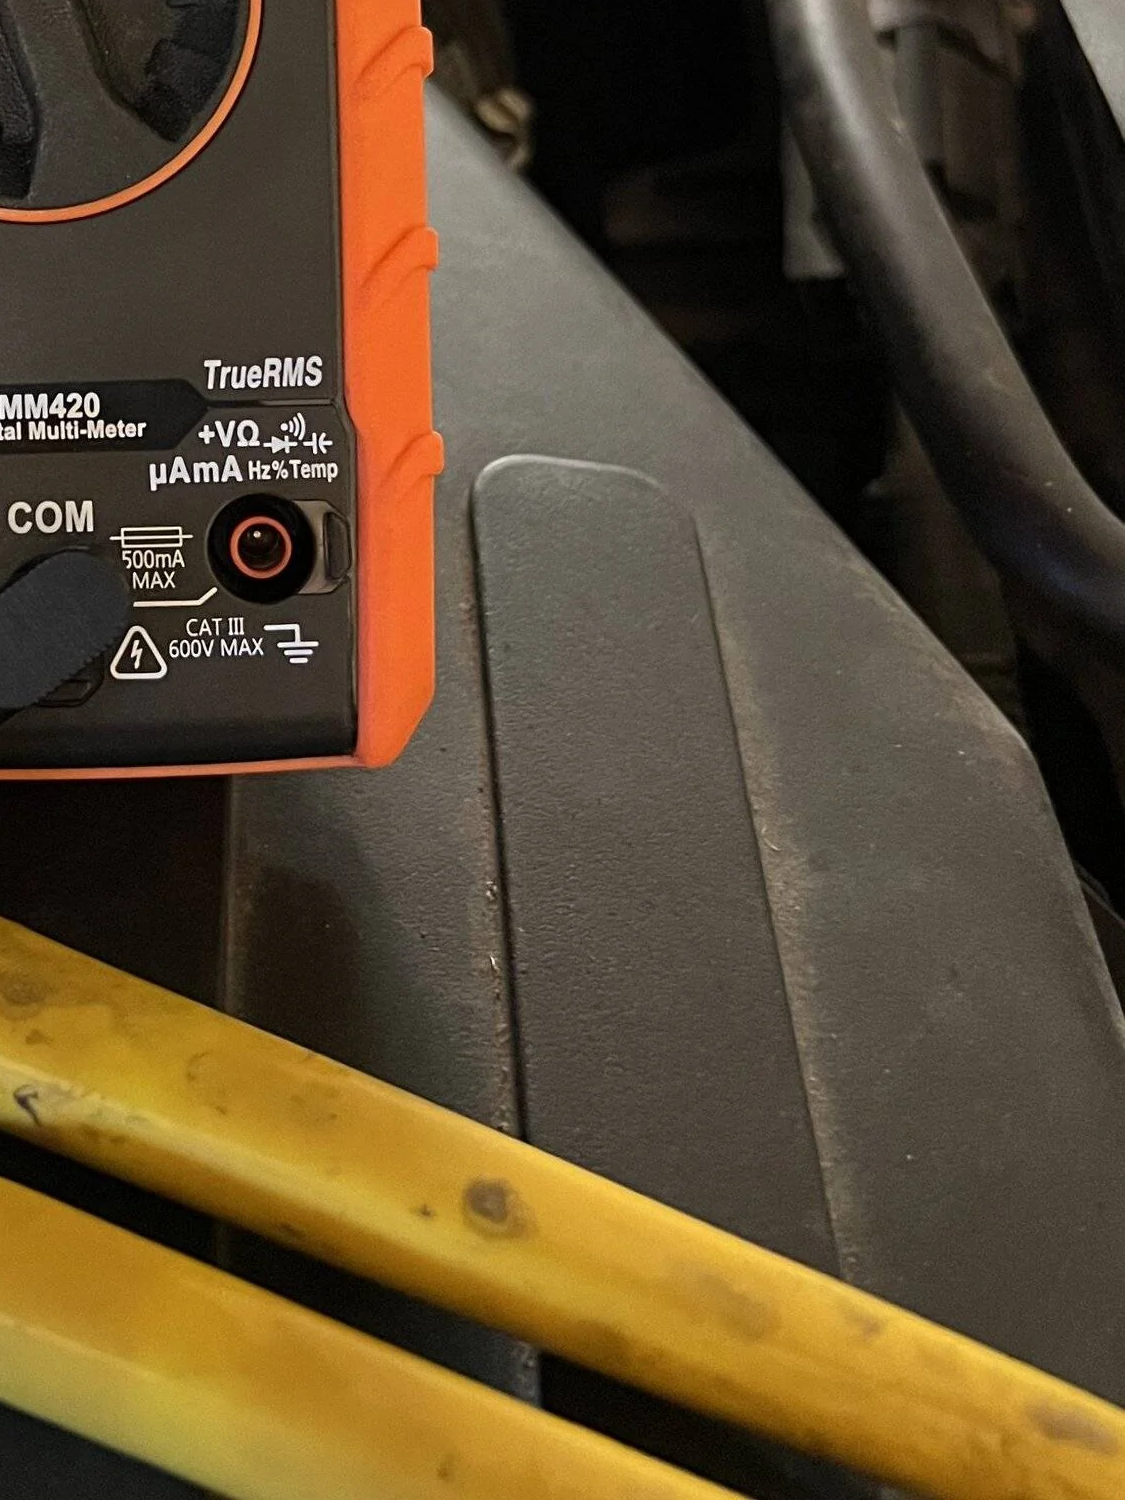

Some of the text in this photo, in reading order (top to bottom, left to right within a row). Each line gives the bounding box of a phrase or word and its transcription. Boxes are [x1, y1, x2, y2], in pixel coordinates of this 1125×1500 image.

[204, 356, 323, 390] TrueRMS
[28, 419, 147, 442] Multi-Meter
[8, 501, 94, 533] COM
[121, 550, 185, 569] 500mA
[132, 571, 176, 590] MAX
[186, 617, 245, 637] CAT III
[169, 637, 266, 658] 600V MAX
